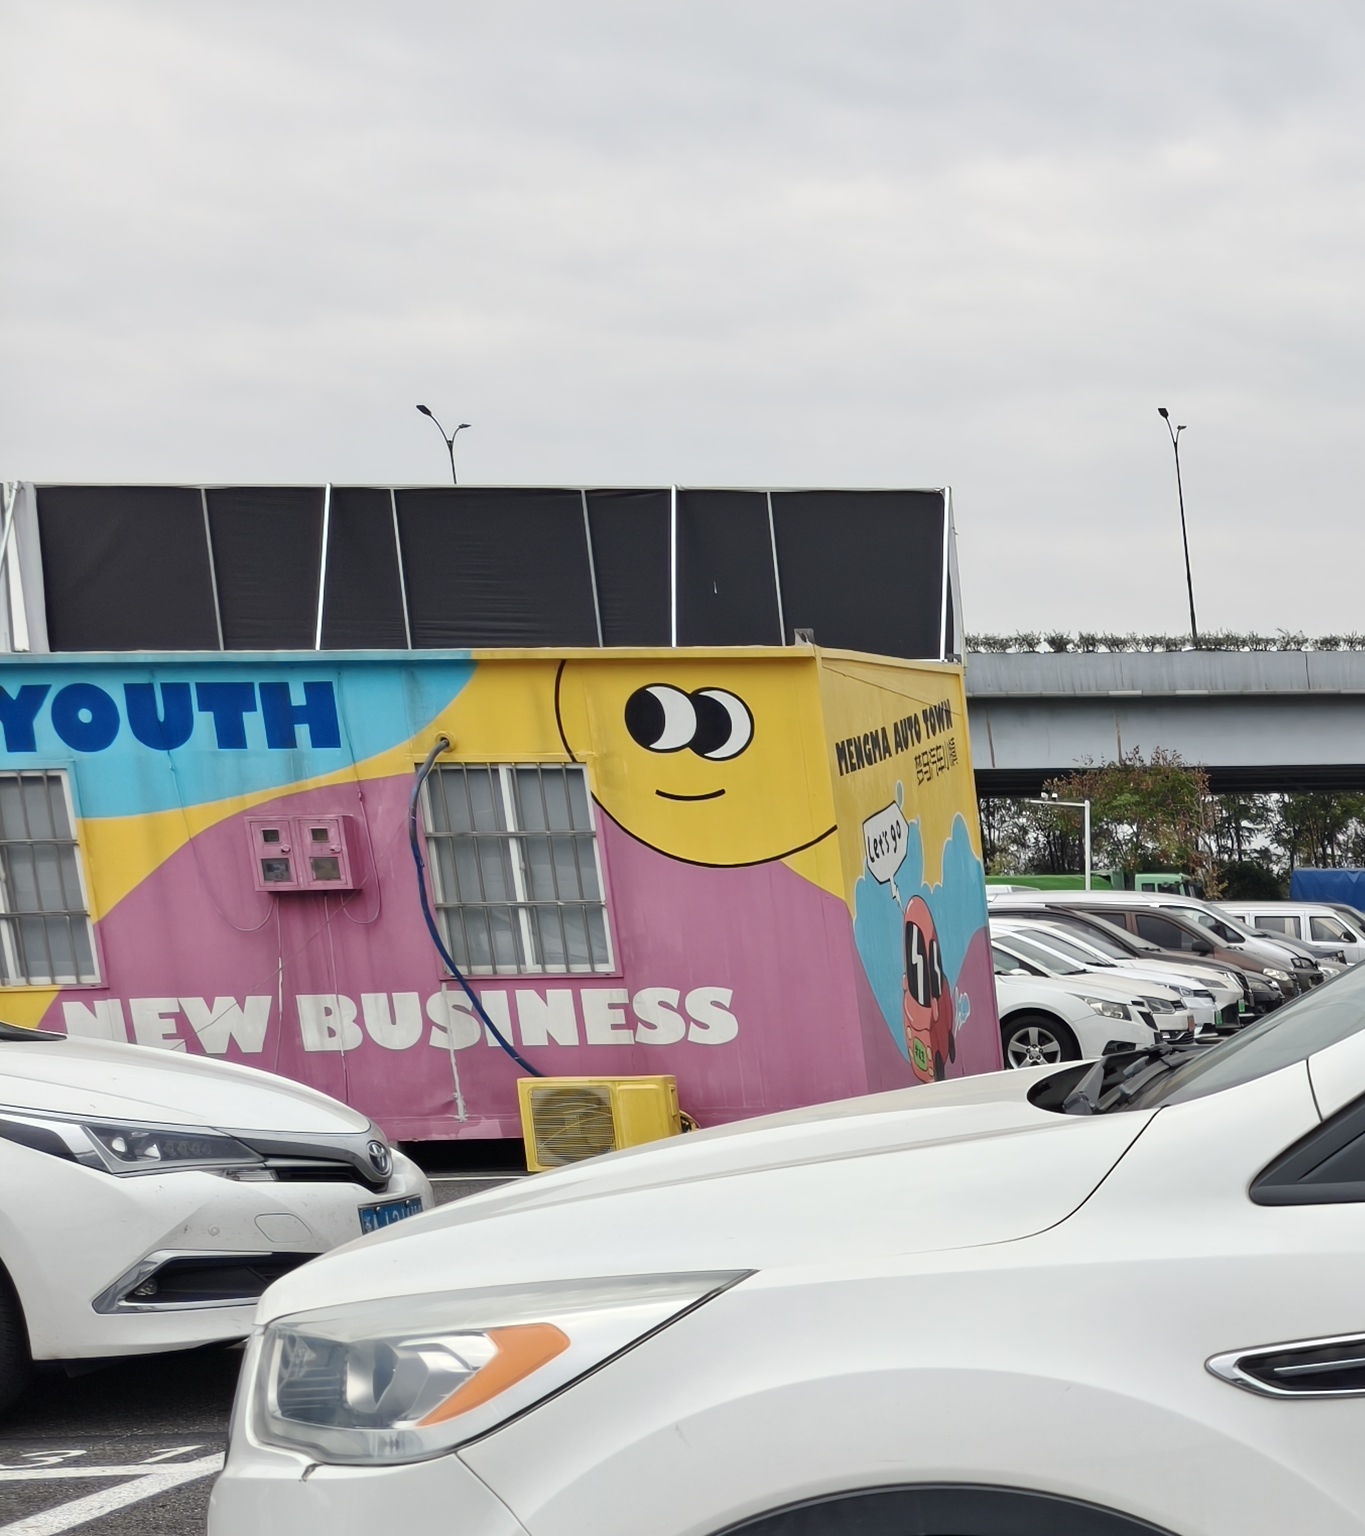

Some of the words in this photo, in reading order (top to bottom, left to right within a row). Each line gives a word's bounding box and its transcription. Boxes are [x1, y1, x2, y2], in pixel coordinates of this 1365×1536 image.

[0, 681, 342, 752] YOUTH
[835, 726, 892, 776] MENGMA
[893, 713, 922, 754] AUTO
[922, 699, 953, 739] TOWN
[62, 995, 272, 1053] NEW
[296, 986, 739, 1052] BUSINESS
